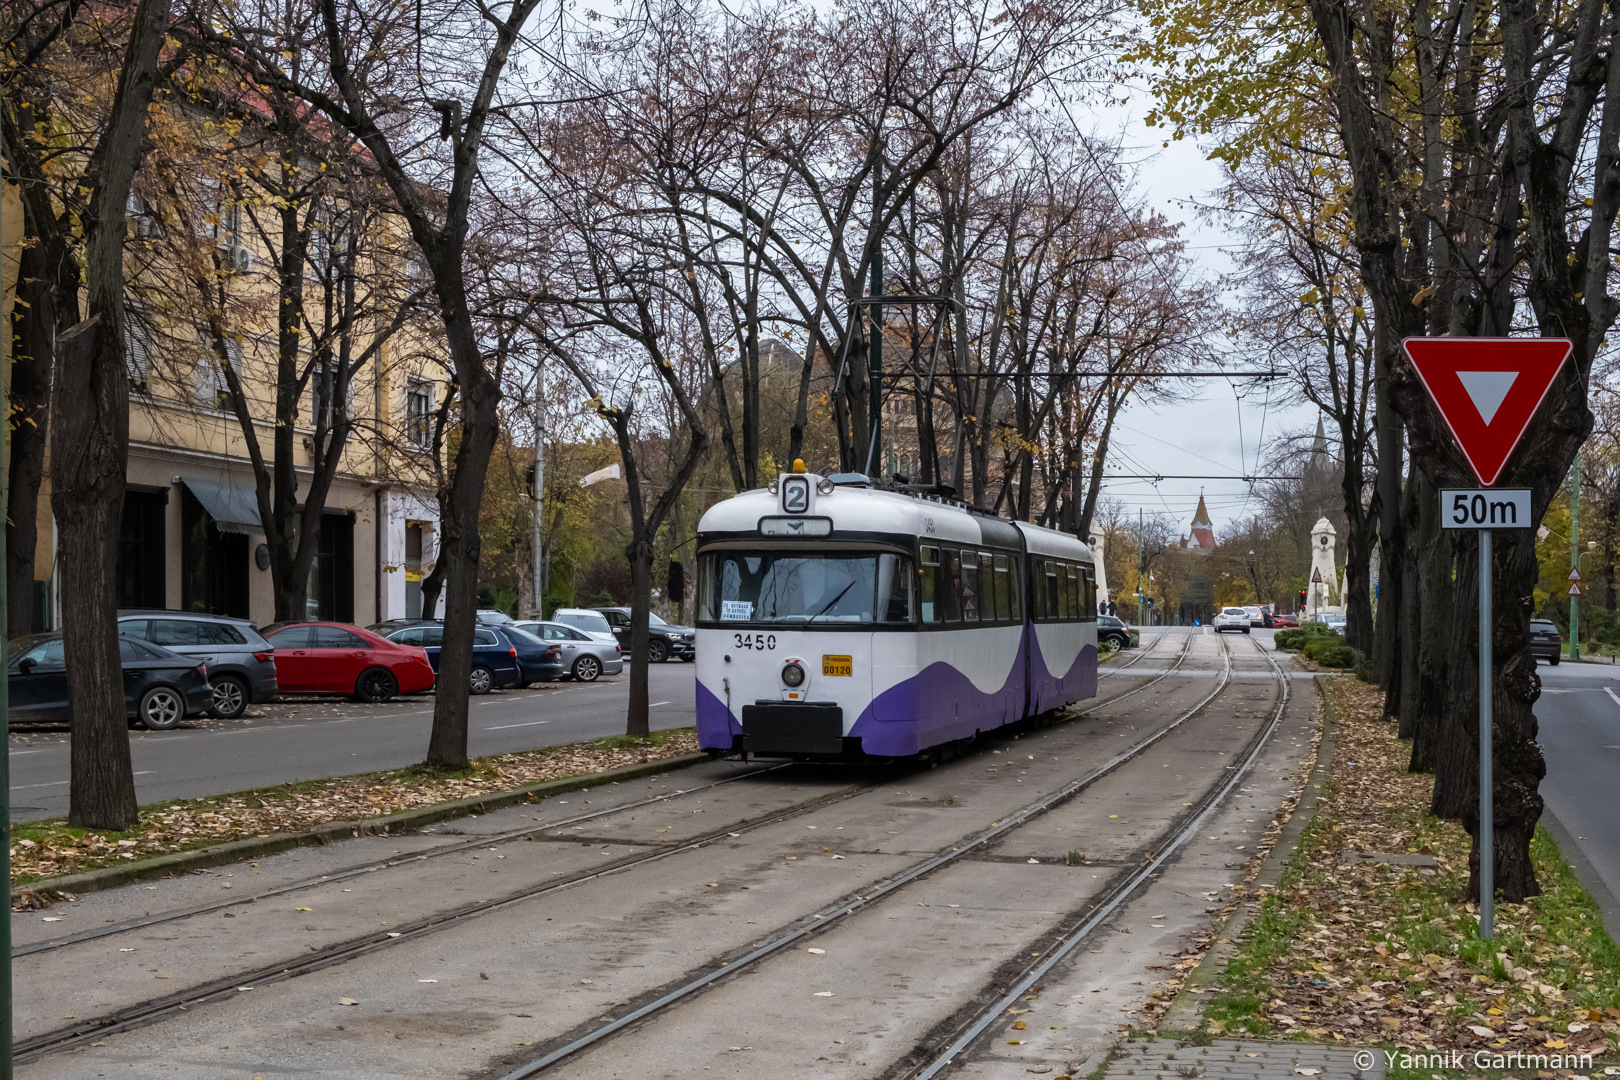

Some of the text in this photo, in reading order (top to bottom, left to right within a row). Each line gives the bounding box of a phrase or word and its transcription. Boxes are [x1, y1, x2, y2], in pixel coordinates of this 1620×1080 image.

[788, 486, 805, 507] 2
[1452, 494, 1517, 524] 50m
[734, 633, 776, 650] 3450
[824, 665, 851, 674] 00120
